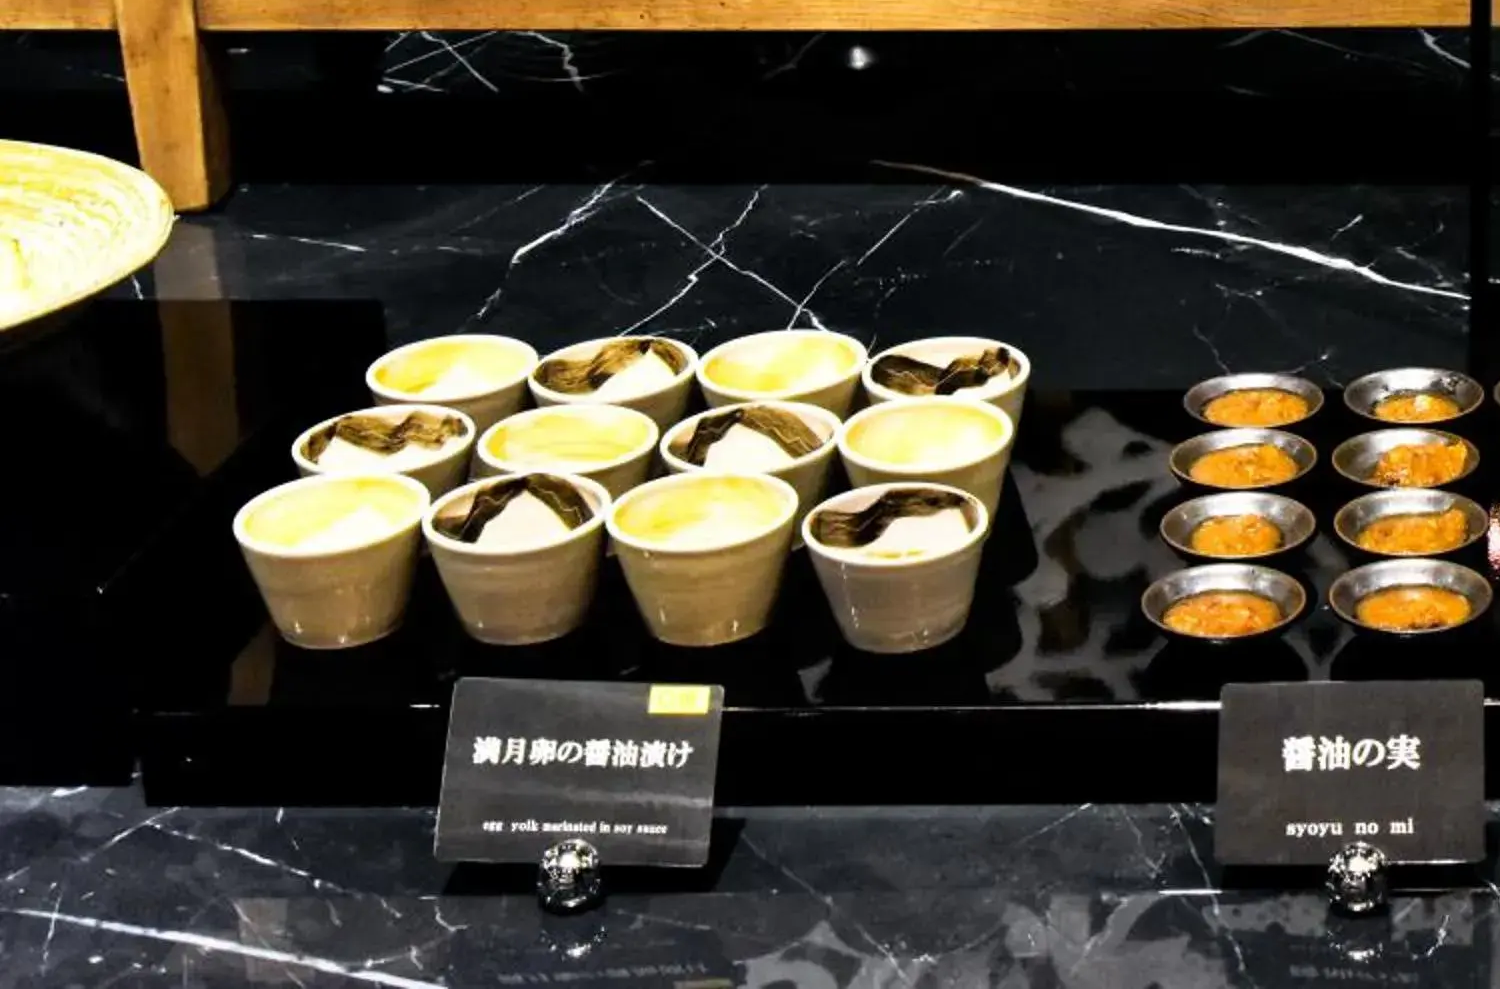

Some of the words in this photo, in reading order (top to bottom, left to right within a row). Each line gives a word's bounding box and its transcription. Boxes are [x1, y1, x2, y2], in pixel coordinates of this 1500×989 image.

[1281, 734, 1422, 772] 醤油の実
[482, 821, 504, 832] egg
[511, 819, 539, 833] yolk
[599, 820, 611, 833] in
[613, 823, 633, 835] soy
[636, 823, 669, 835] sauce
[1285, 820, 1344, 838] syoyu
[1354, 820, 1379, 835] no
[1389, 817, 1415, 835] mi
